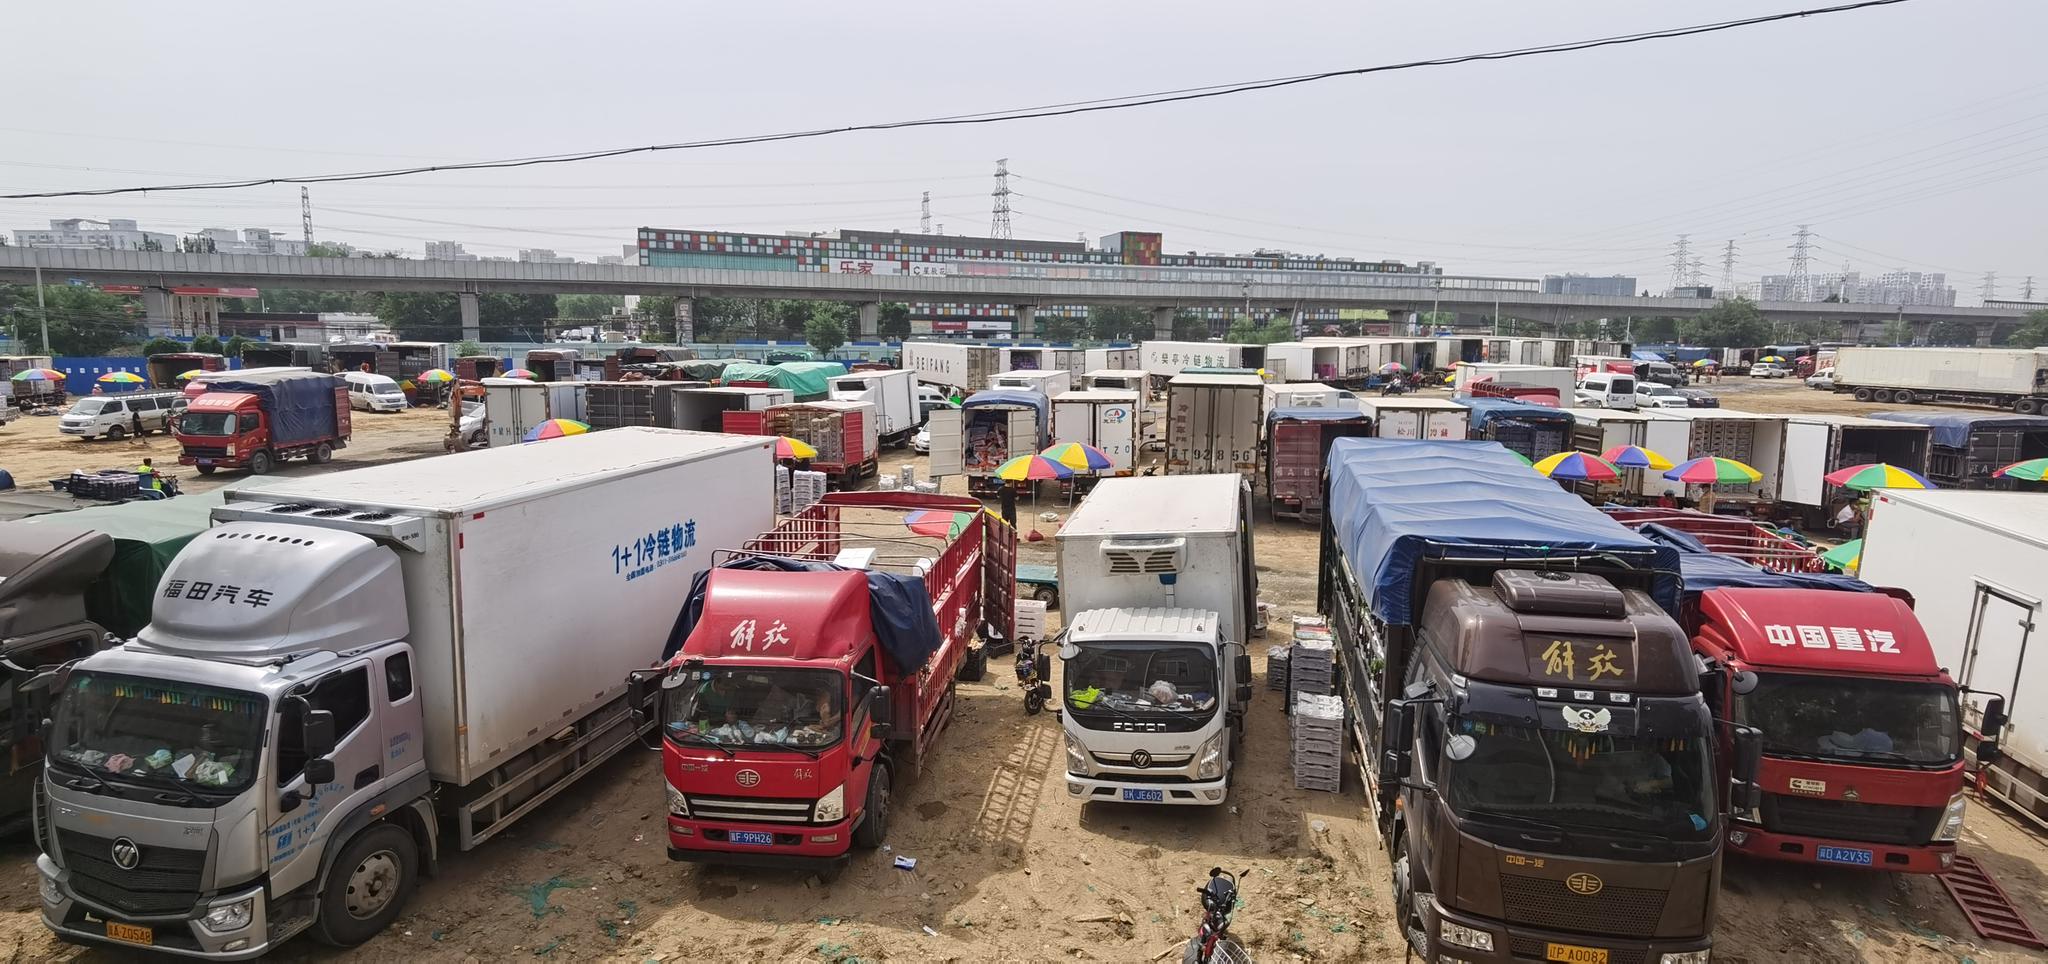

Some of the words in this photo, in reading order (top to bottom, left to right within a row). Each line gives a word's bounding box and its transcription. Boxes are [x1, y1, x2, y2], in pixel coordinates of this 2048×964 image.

[916, 356, 950, 374] BEIFANG
[611, 518, 697, 575] 1+1冷链物流
[163, 579, 274, 608] 福田汽车
[730, 619, 790, 651] 解放
[1764, 624, 1901, 654] 中国重汽
[1542, 640, 1624, 681] 解放
[1113, 722, 1166, 733] FOTON
[1505, 855, 1545, 868] 中国一汽
